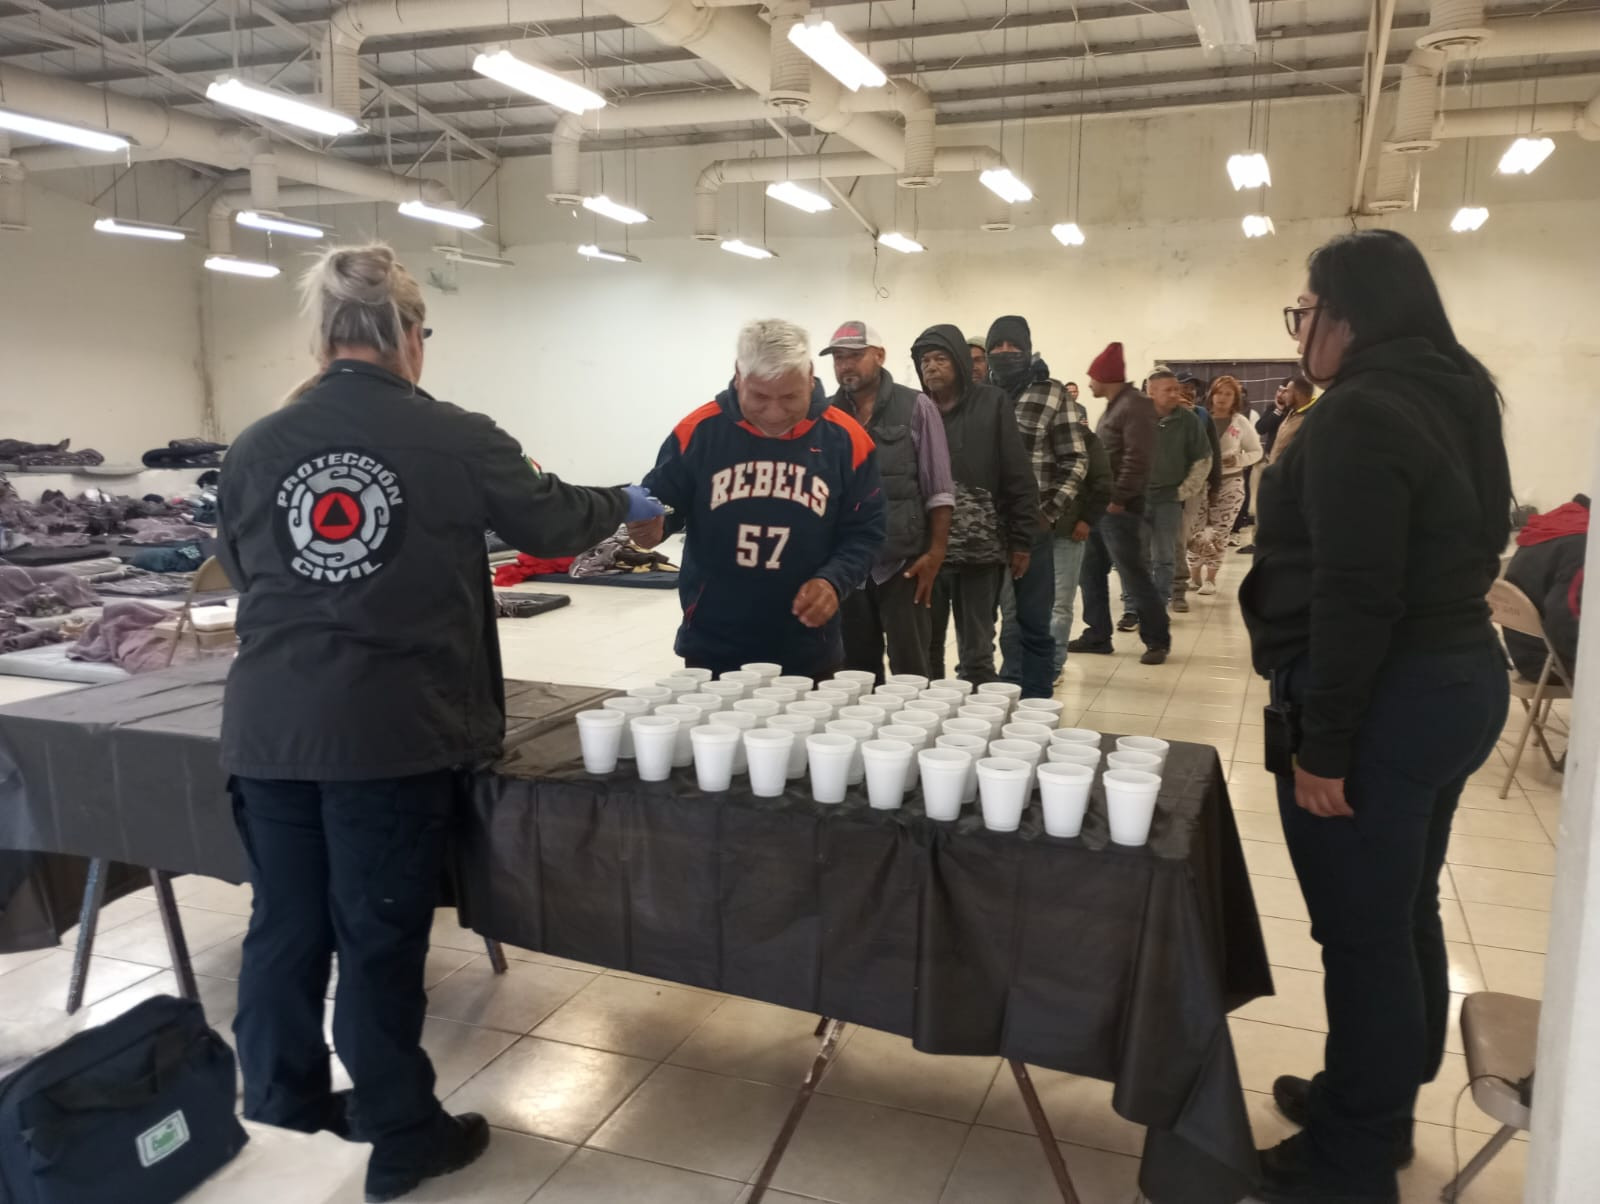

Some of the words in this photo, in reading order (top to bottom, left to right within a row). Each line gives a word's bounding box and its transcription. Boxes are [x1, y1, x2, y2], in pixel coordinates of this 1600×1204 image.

[277, 452, 403, 508] PROTECCIÓN
[710, 461, 830, 517] REBELS
[291, 556, 383, 582] CIVIL
[736, 523, 791, 569] 57
